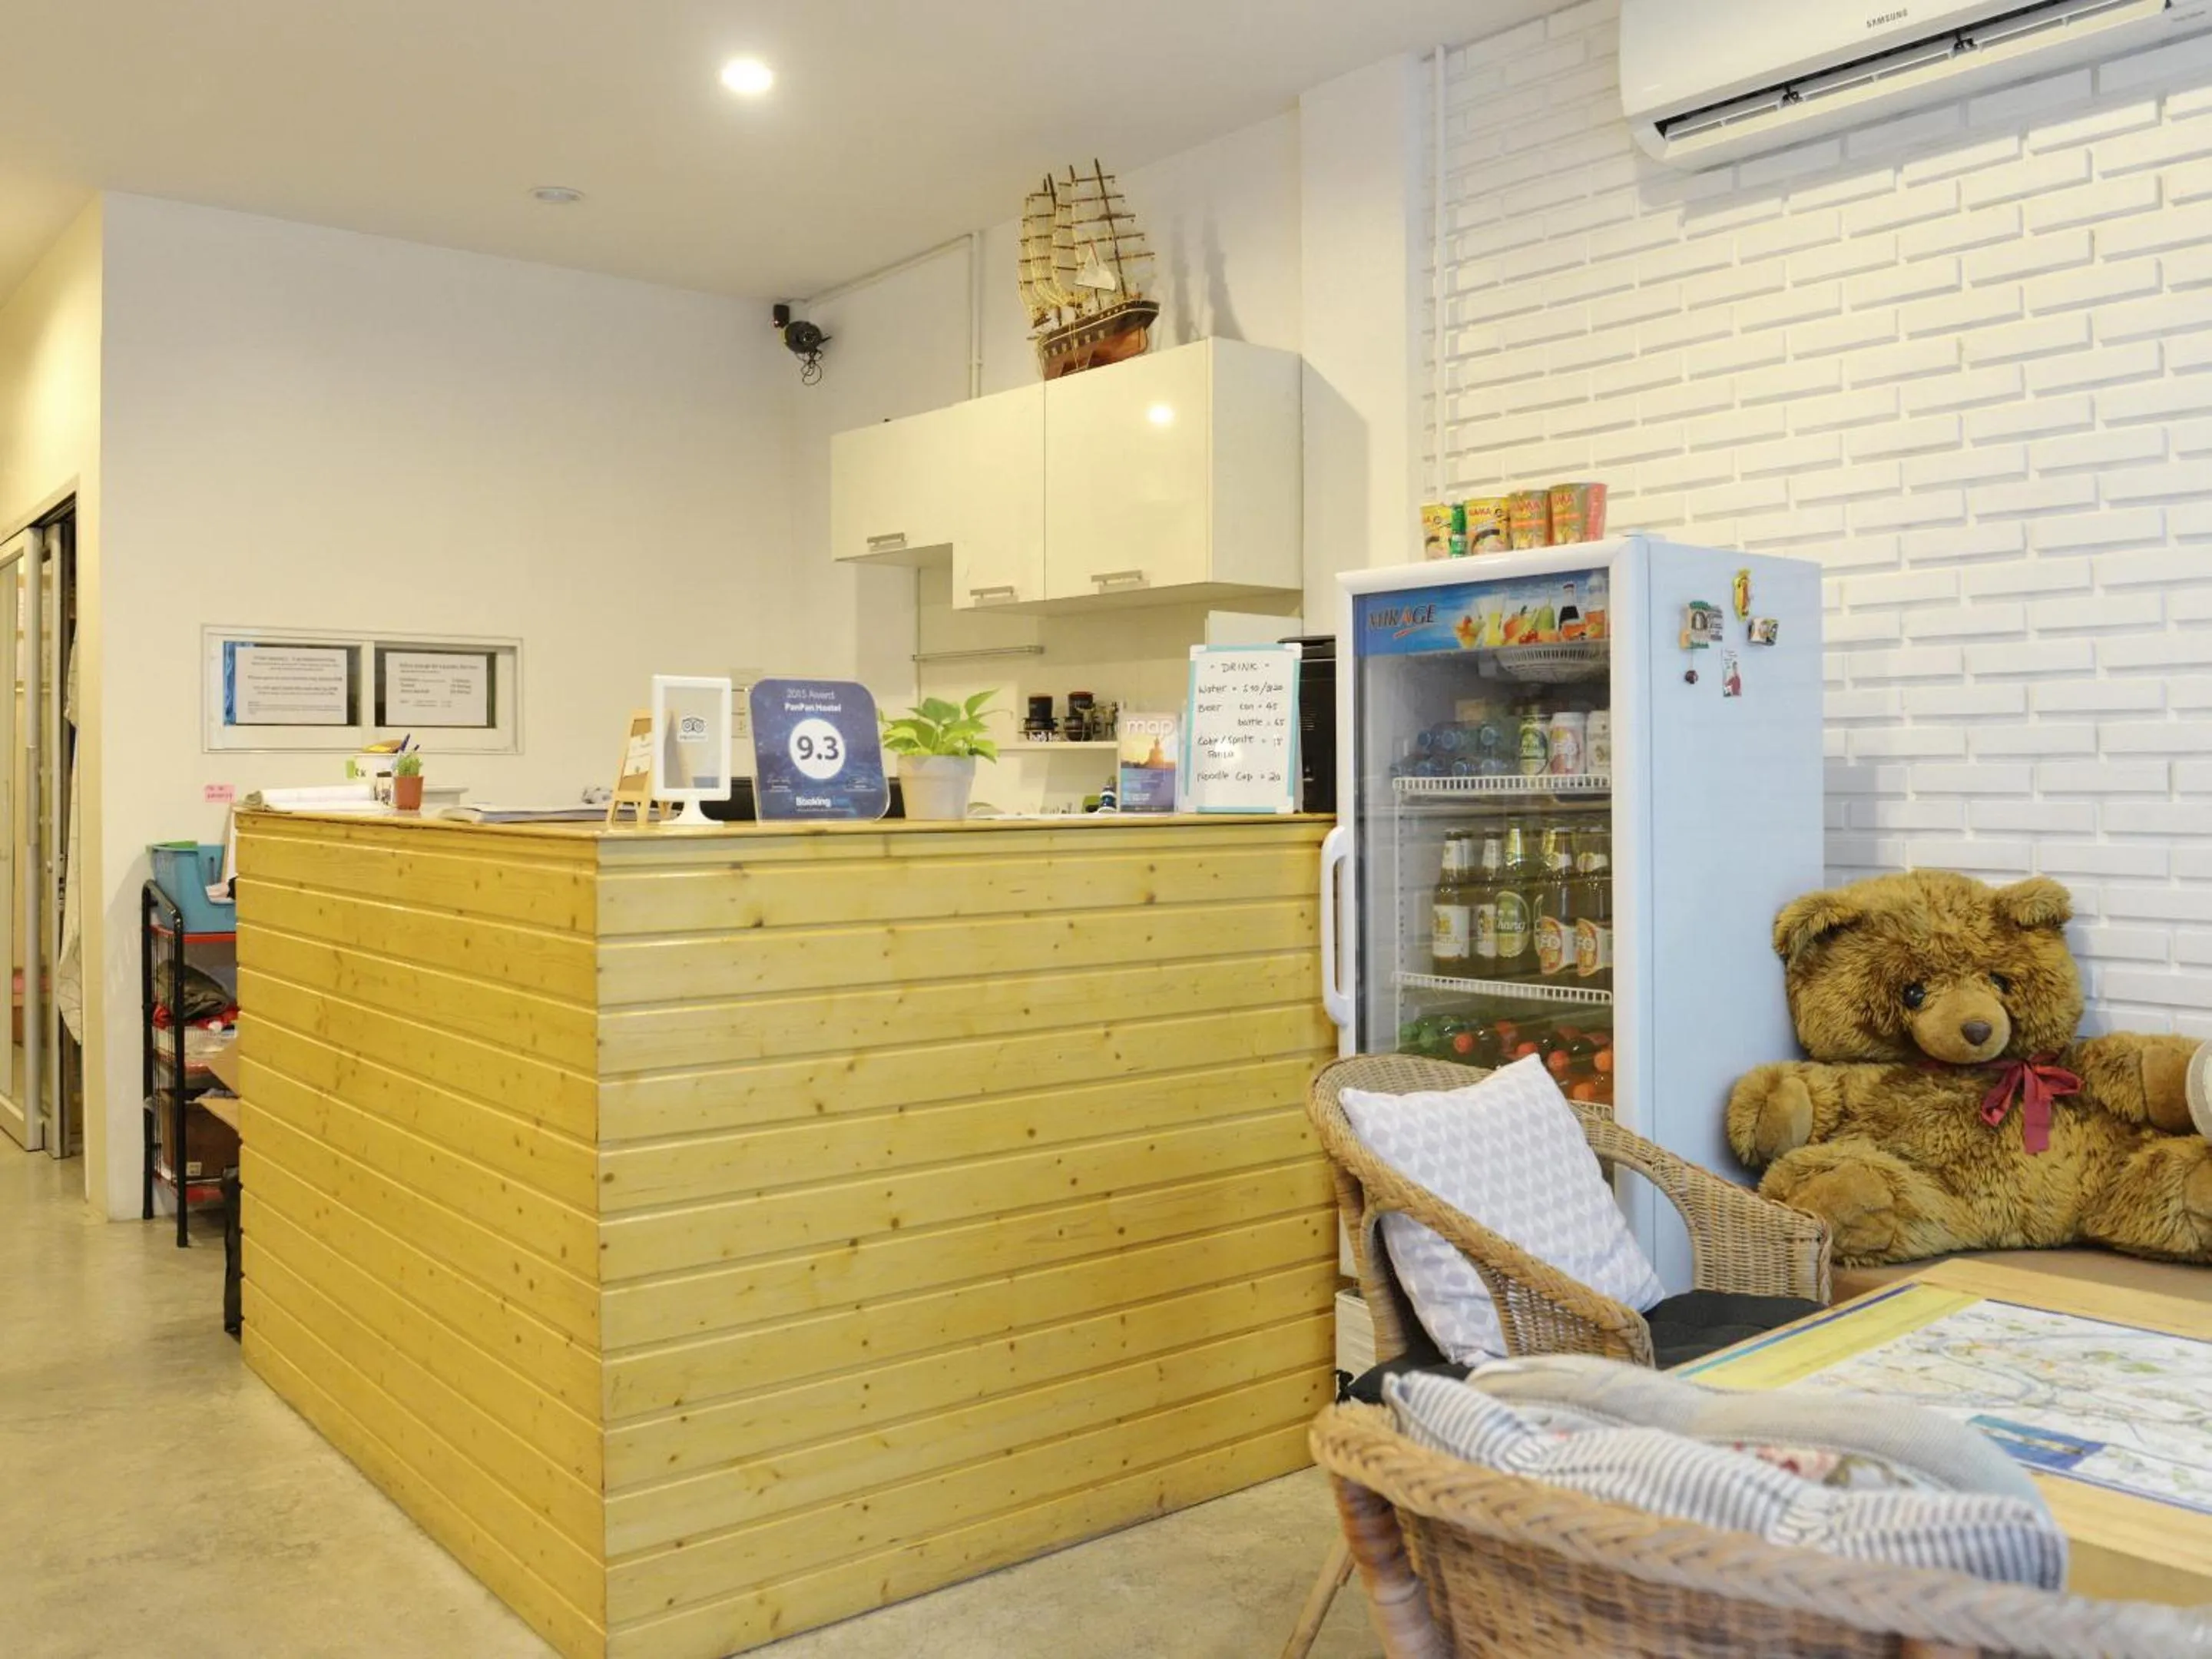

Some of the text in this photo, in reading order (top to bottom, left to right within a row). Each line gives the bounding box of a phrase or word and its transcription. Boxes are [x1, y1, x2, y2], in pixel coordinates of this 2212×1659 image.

[1866, 8, 1908, 28] SAMSUNG
[1221, 662, 1258, 673] DRINK
[1127, 719, 1174, 739] map
[796, 735, 839, 760] 9.3
[1497, 919, 1526, 932] hang
